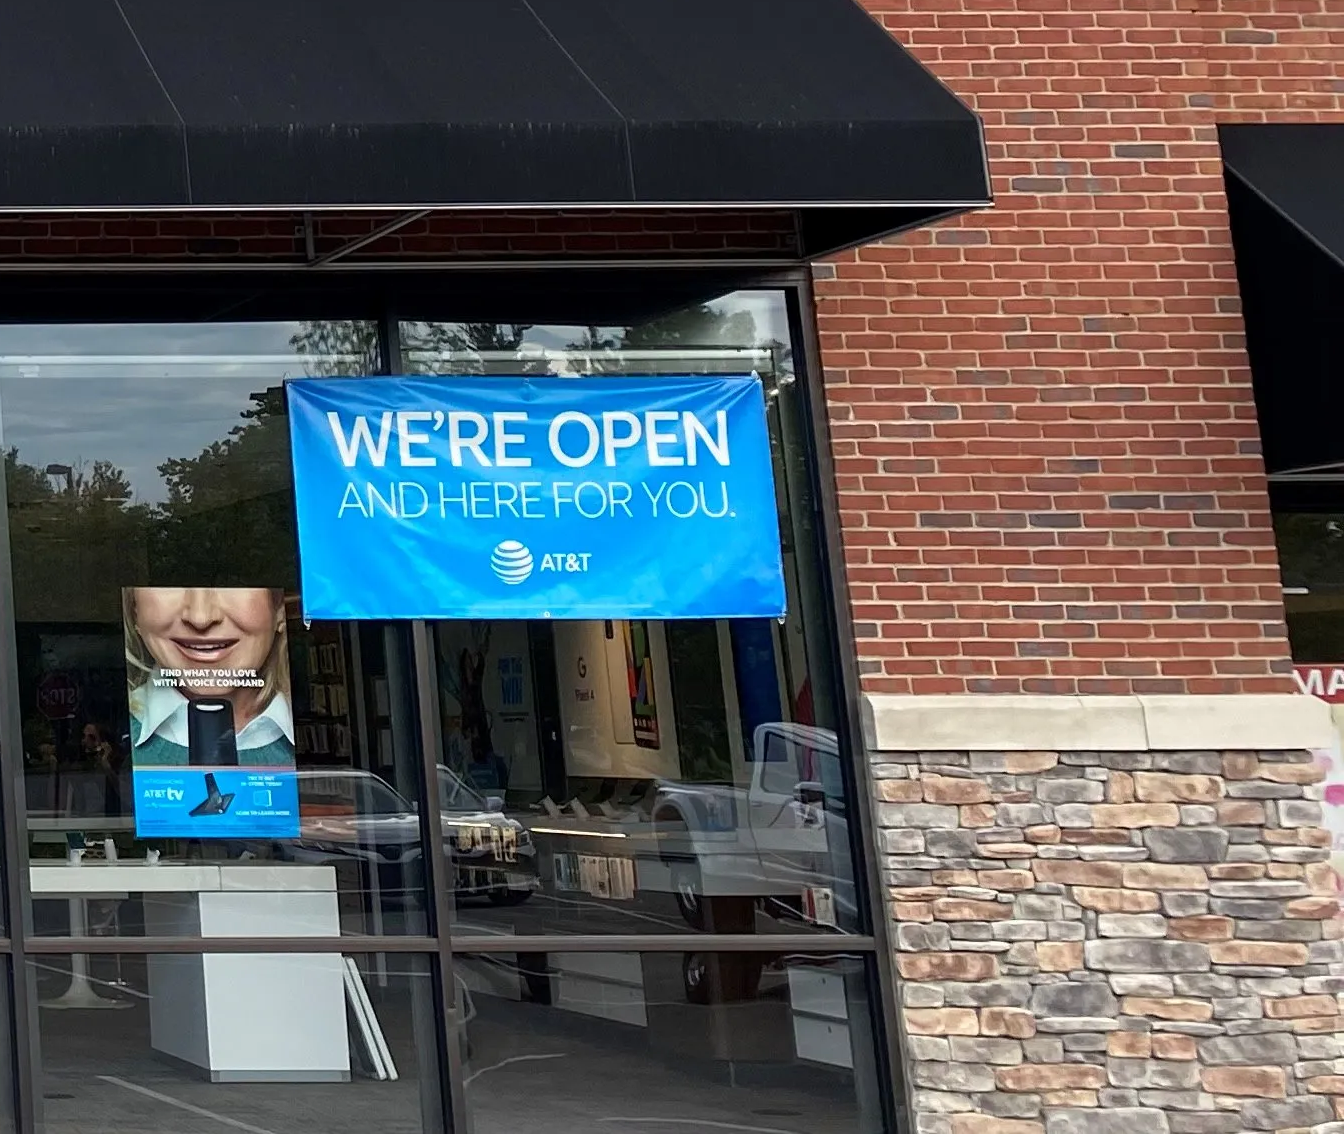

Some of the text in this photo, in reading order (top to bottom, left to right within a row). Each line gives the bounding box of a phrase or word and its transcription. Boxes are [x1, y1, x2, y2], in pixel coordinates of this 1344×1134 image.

[326, 410, 731, 468] WE'RE OPEN
[337, 480, 737, 519] AND HERE FOR YOU.
[540, 553, 592, 573] AT&T
[160, 668, 257, 678] FIND WHAT YOU LOVE
[153, 678, 265, 688] WITH A VOICE COMMAND
[143, 787, 185, 801] AT&T tv
